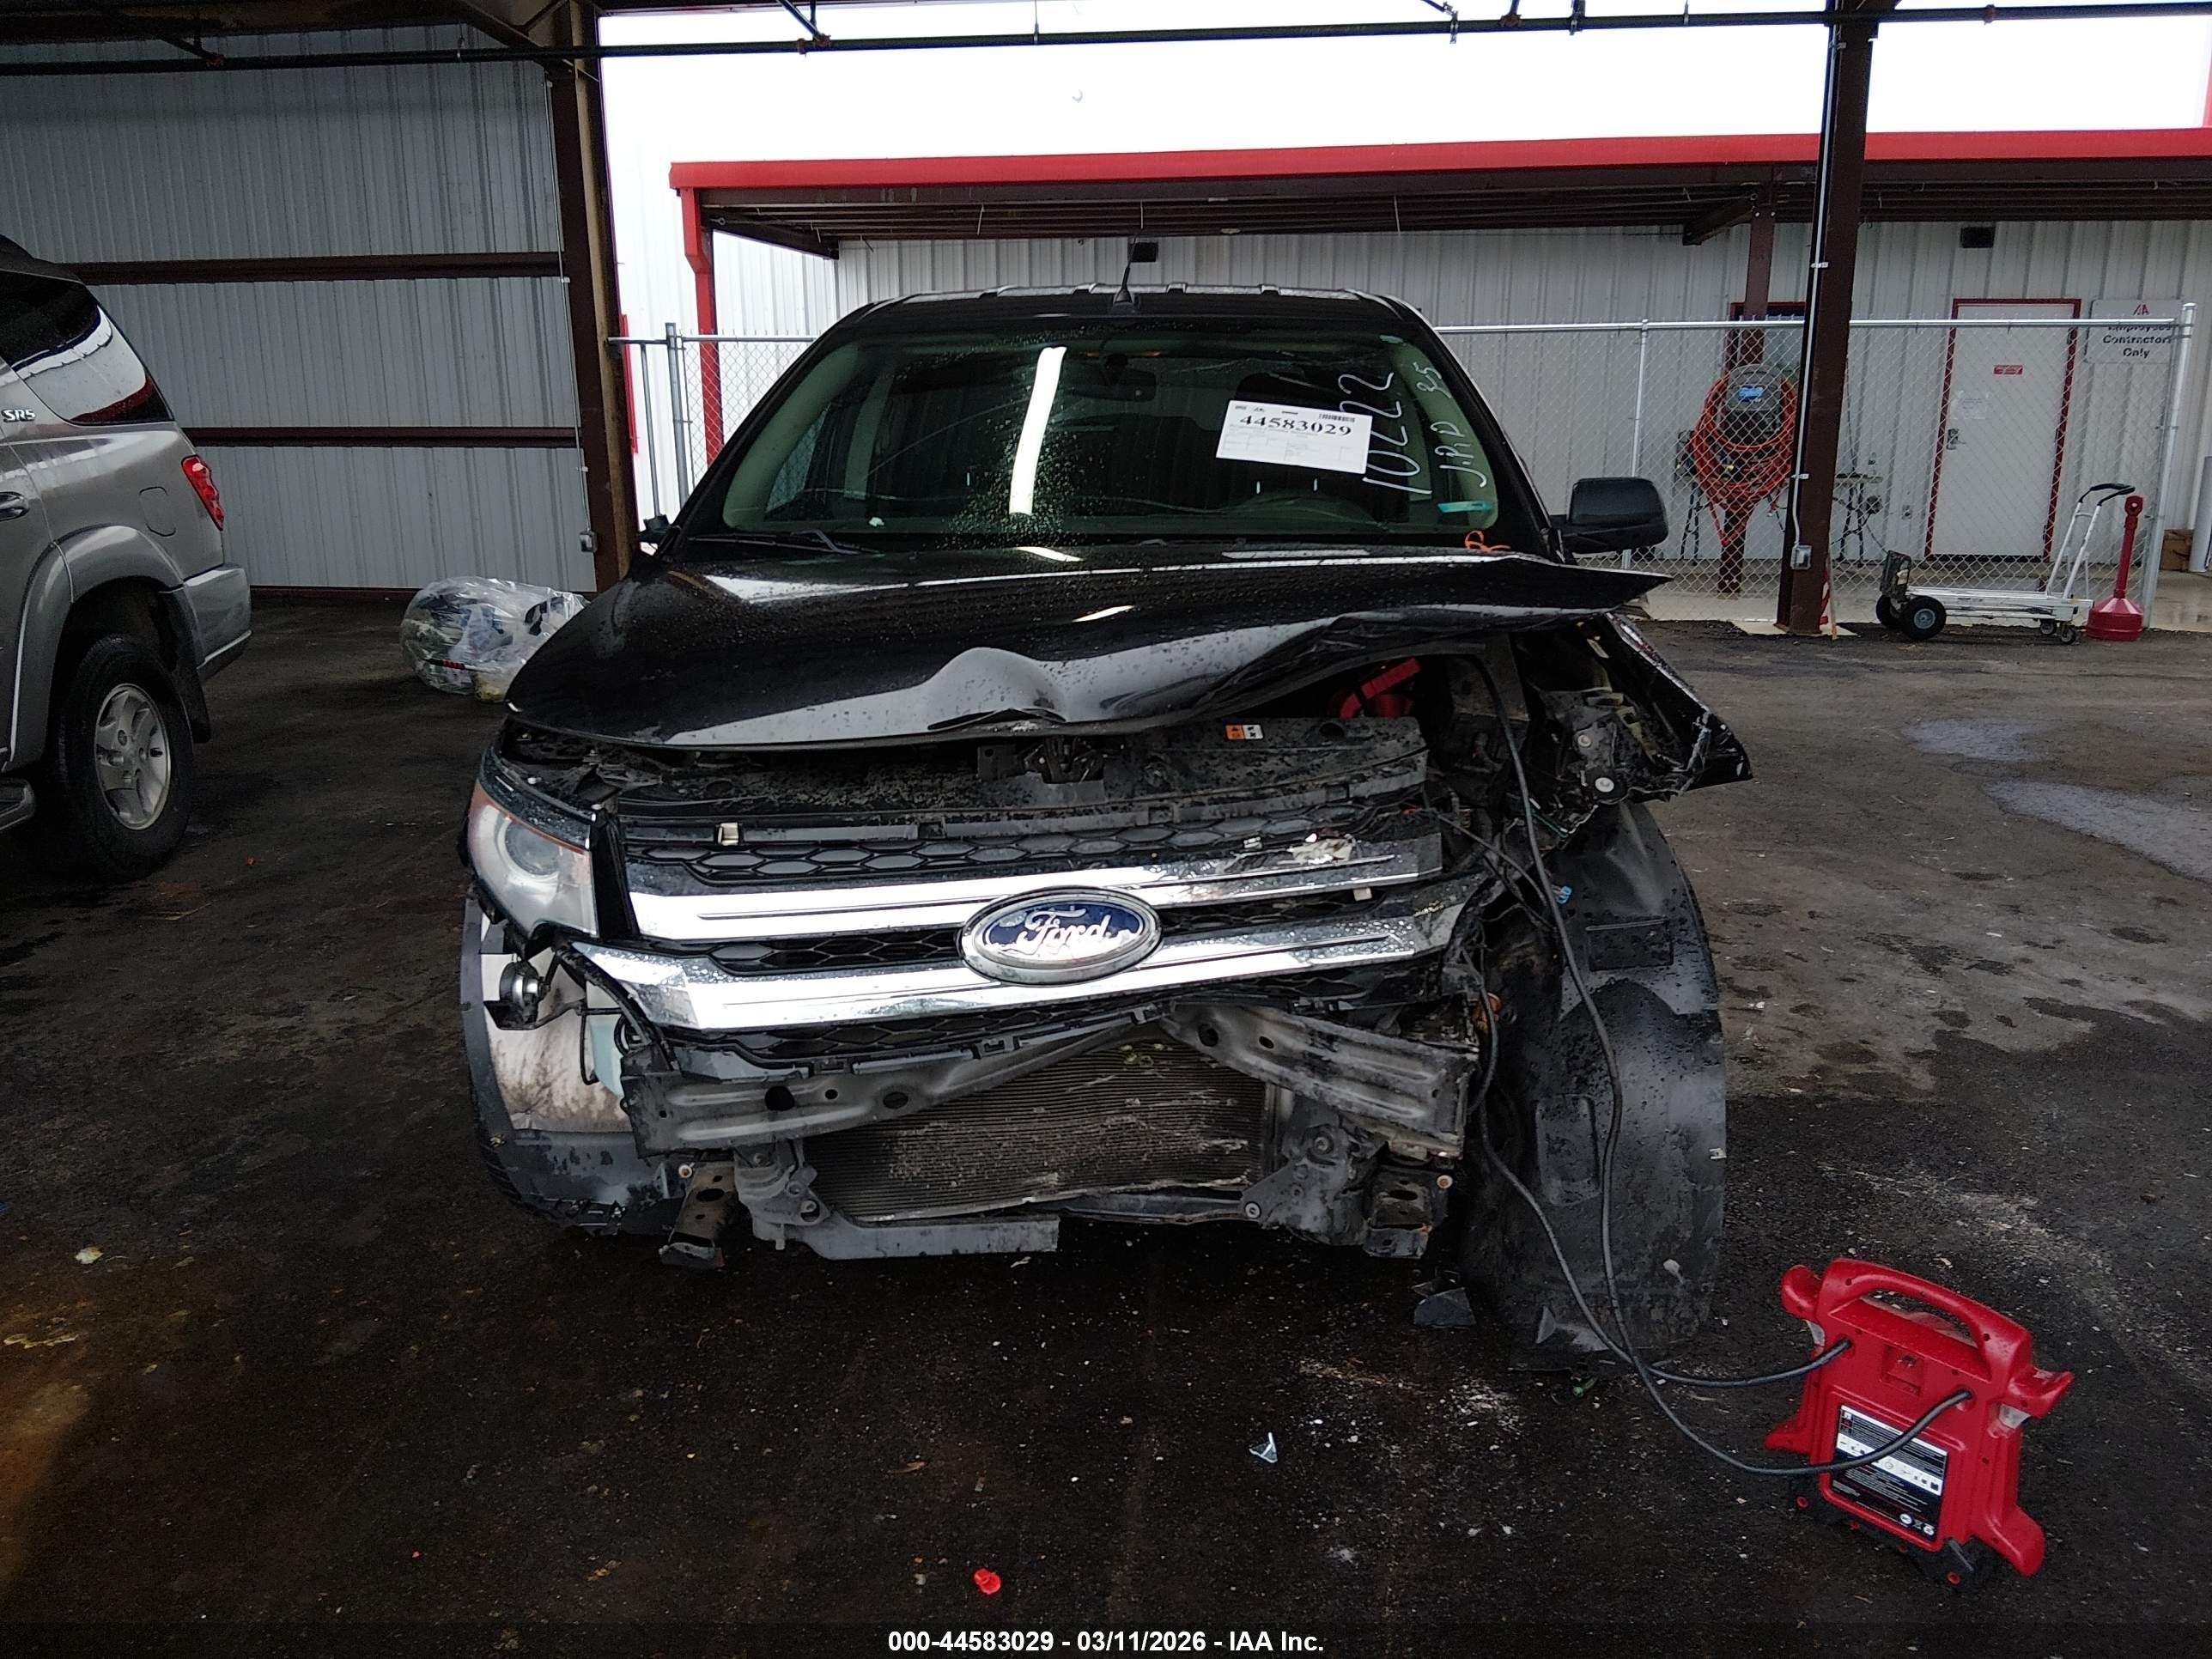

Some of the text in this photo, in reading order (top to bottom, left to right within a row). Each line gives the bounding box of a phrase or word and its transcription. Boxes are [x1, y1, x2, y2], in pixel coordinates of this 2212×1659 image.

[2122, 347, 2150, 359] Only
[2, 408, 35, 422] SR5
[1239, 415, 1352, 437] 44583029
[1014, 905, 1119, 956] Ford
